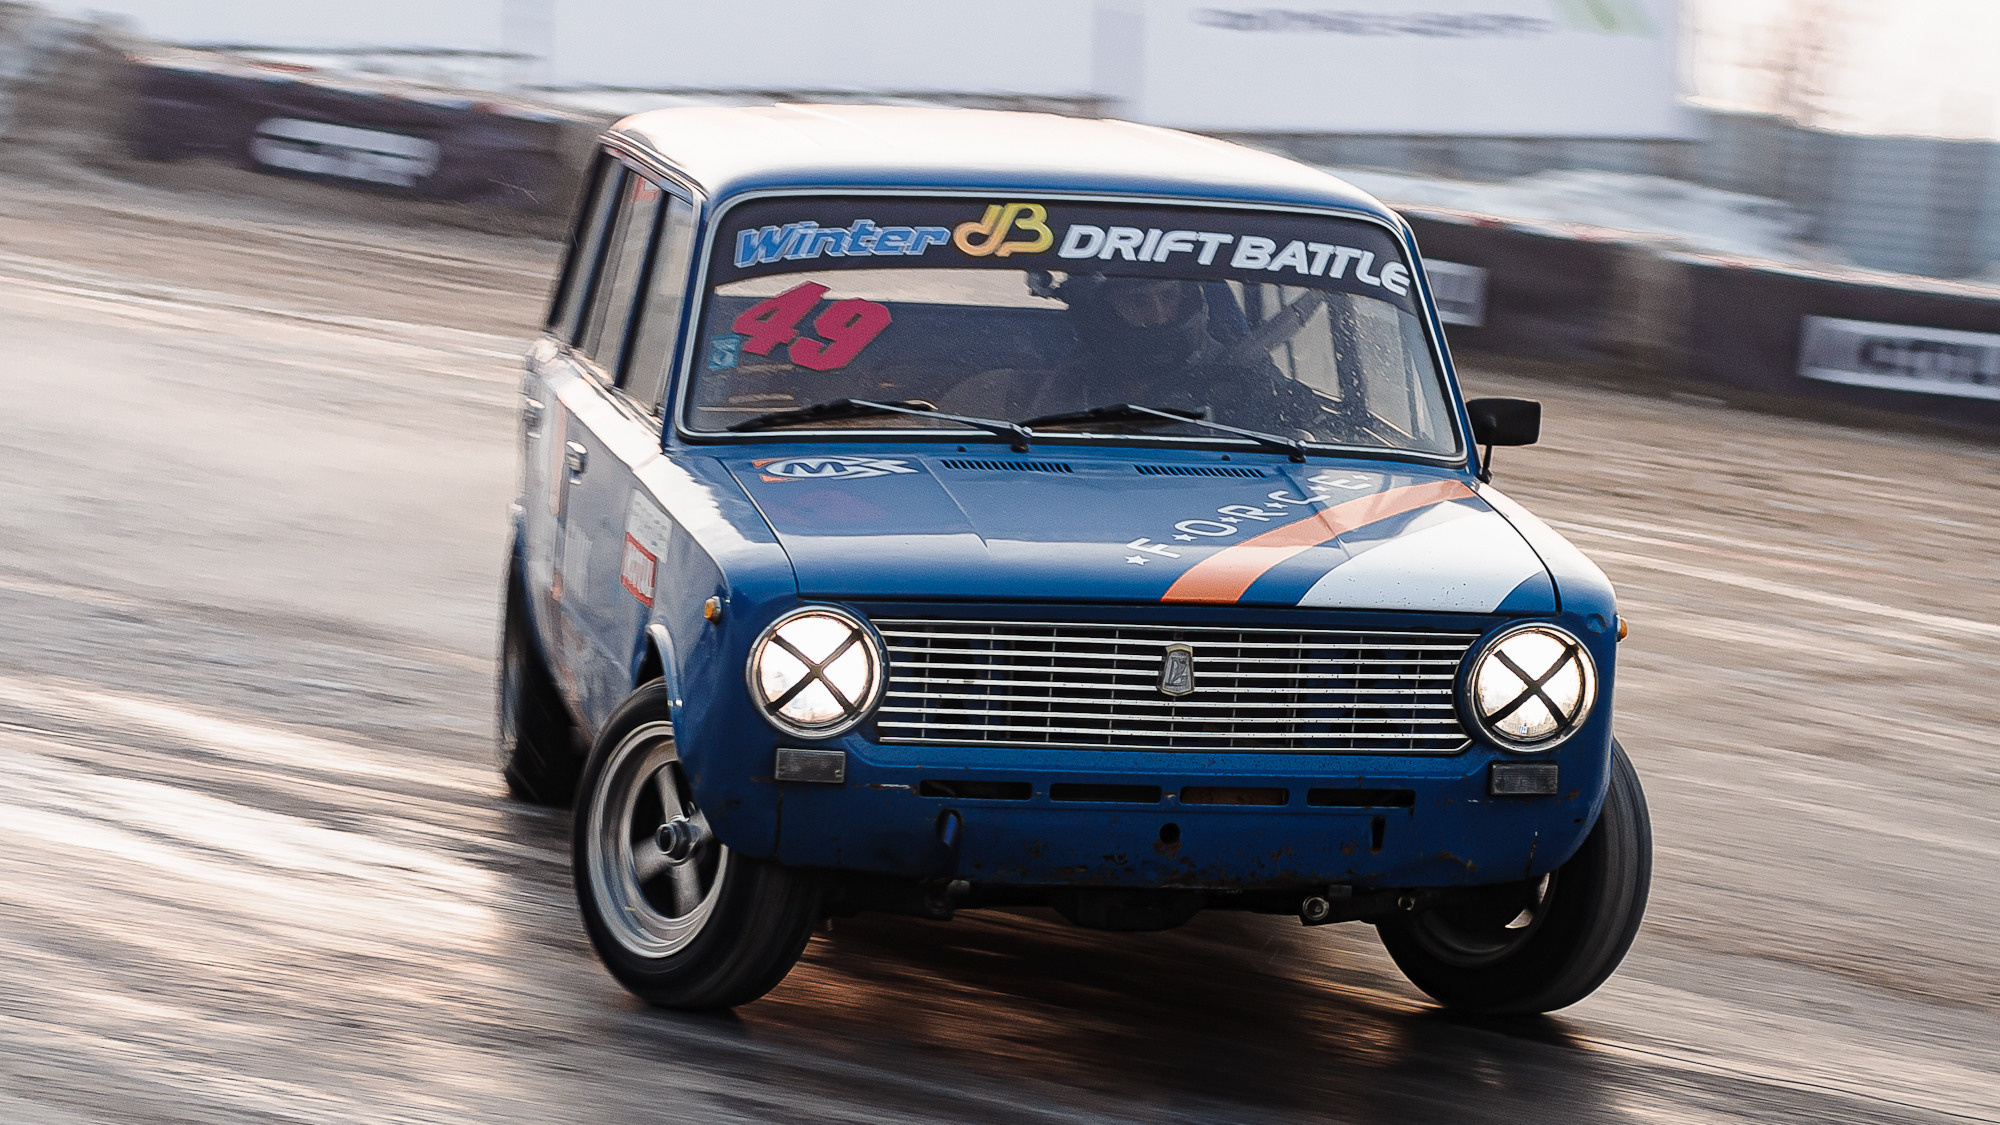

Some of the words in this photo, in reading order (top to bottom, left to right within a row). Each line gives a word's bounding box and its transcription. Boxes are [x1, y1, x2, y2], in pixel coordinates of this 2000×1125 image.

[734, 219, 950, 268] Winter
[1057, 224, 1233, 265] DRIFT
[1230, 234, 1411, 297] BATTLE
[732, 280, 892, 371] 49
